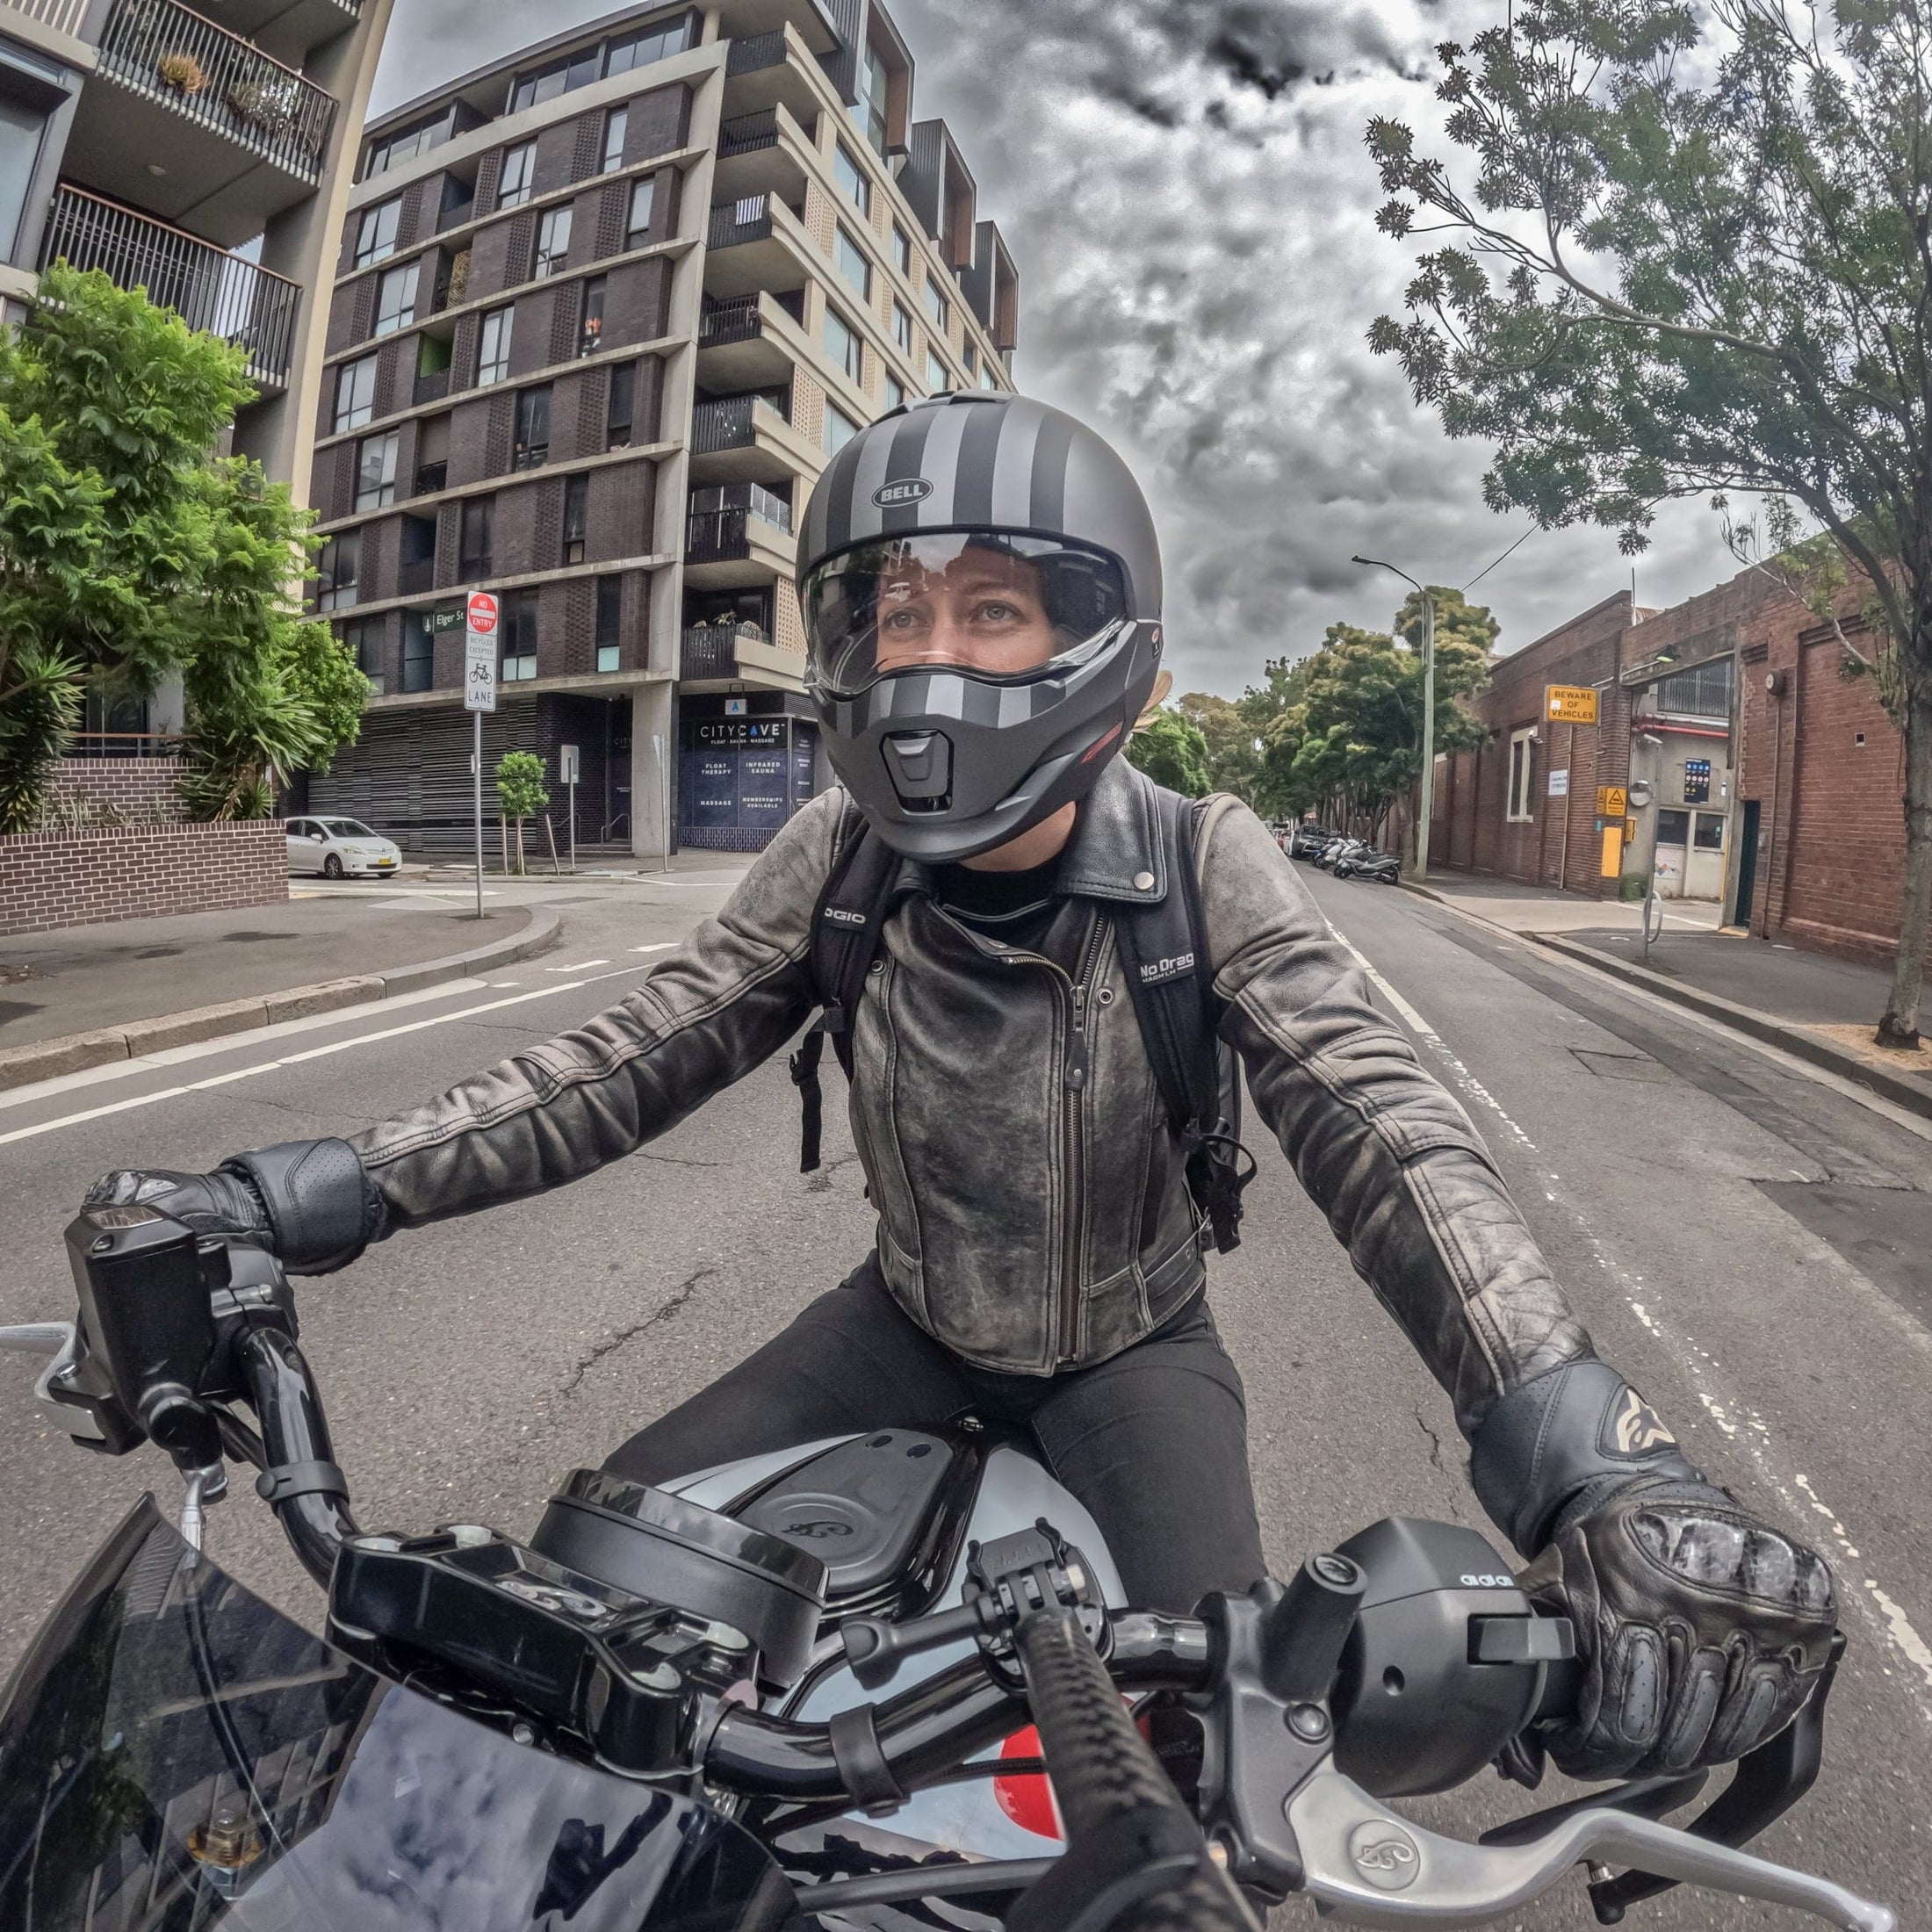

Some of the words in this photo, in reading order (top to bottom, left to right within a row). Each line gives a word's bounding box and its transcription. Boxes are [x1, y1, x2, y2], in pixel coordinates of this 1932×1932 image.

[881, 484, 923, 502] BELL
[479, 600, 488, 609] NO
[436, 614, 455, 626] Elger
[456, 610, 465, 620] St
[472, 617, 493, 628] ENTRY
[468, 690, 493, 703] LANE
[1554, 690, 1592, 701] BEWARE
[1552, 709, 1594, 719] VEHICLES
[1140, 965, 1157, 977] No
[1159, 953, 1194, 972] Drag
